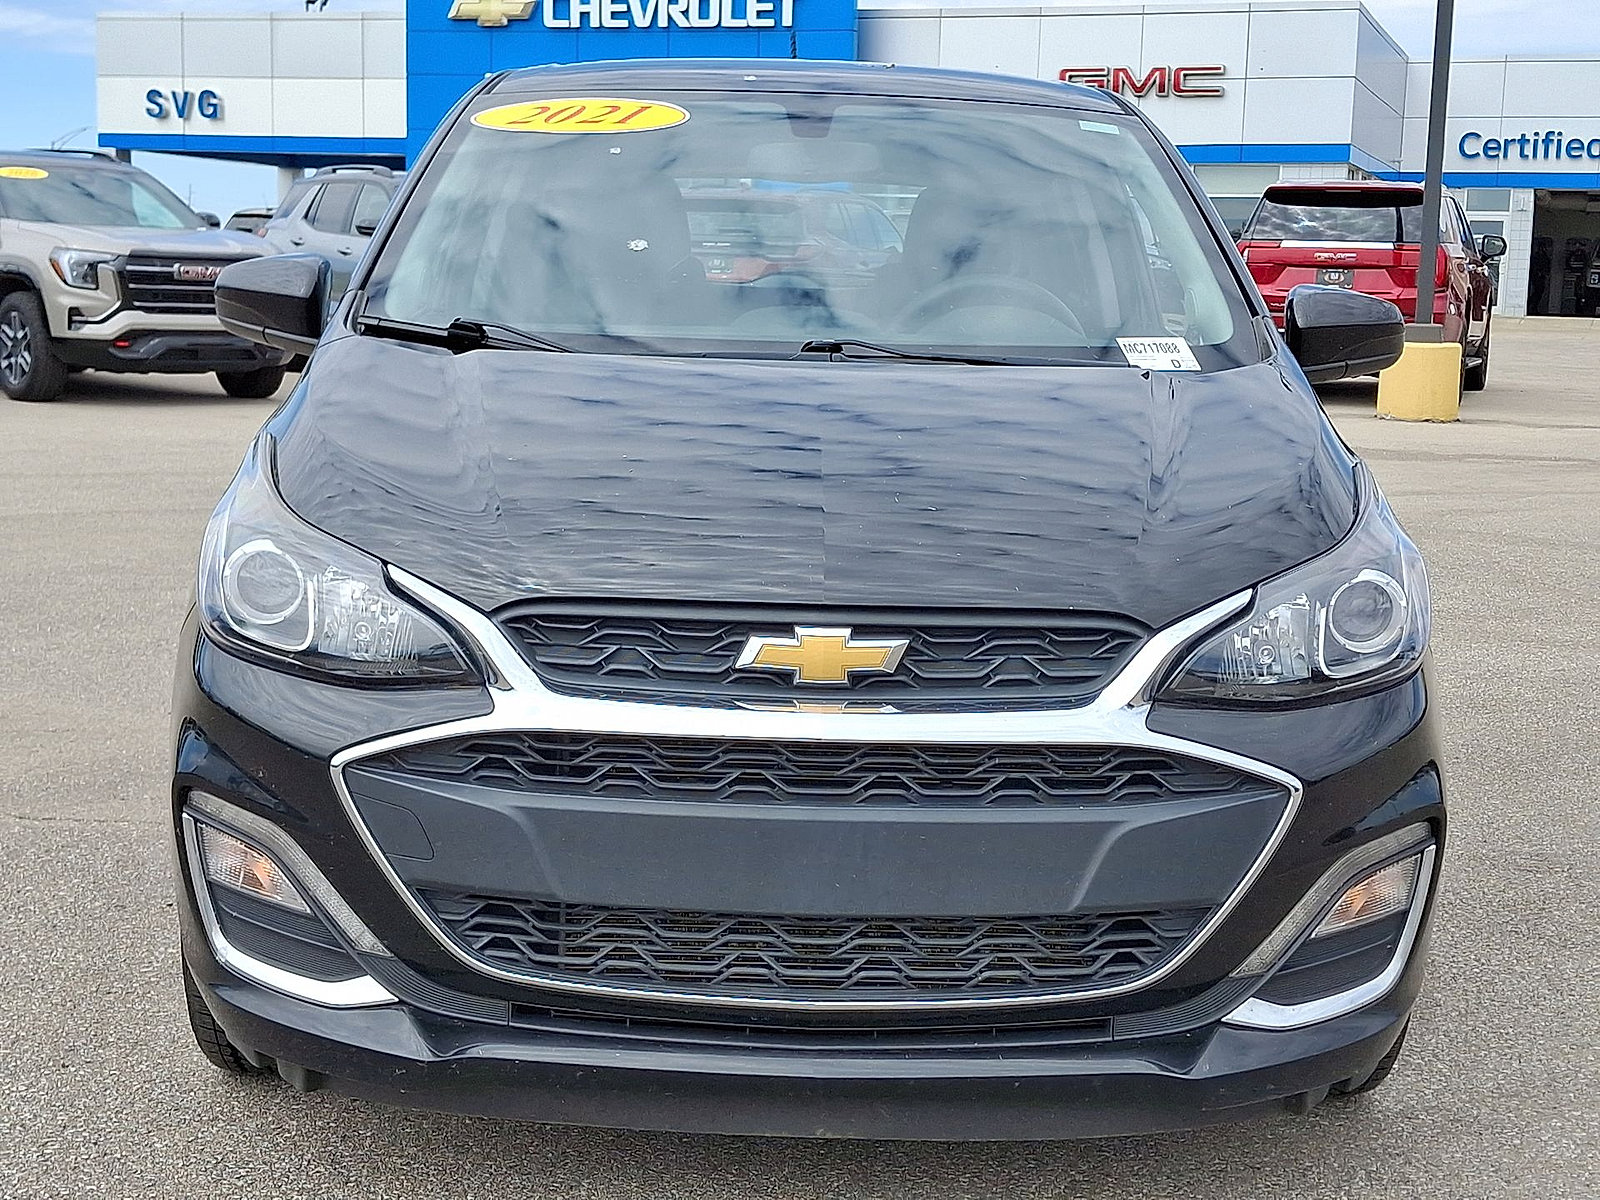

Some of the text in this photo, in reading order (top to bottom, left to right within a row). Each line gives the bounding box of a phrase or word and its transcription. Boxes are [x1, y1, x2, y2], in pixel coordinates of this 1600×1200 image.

[542, 0, 794, 28] CHEVROLET
[1059, 65, 1226, 98] GMC
[145, 89, 222, 120] SVG
[507, 106, 652, 124] 2021
